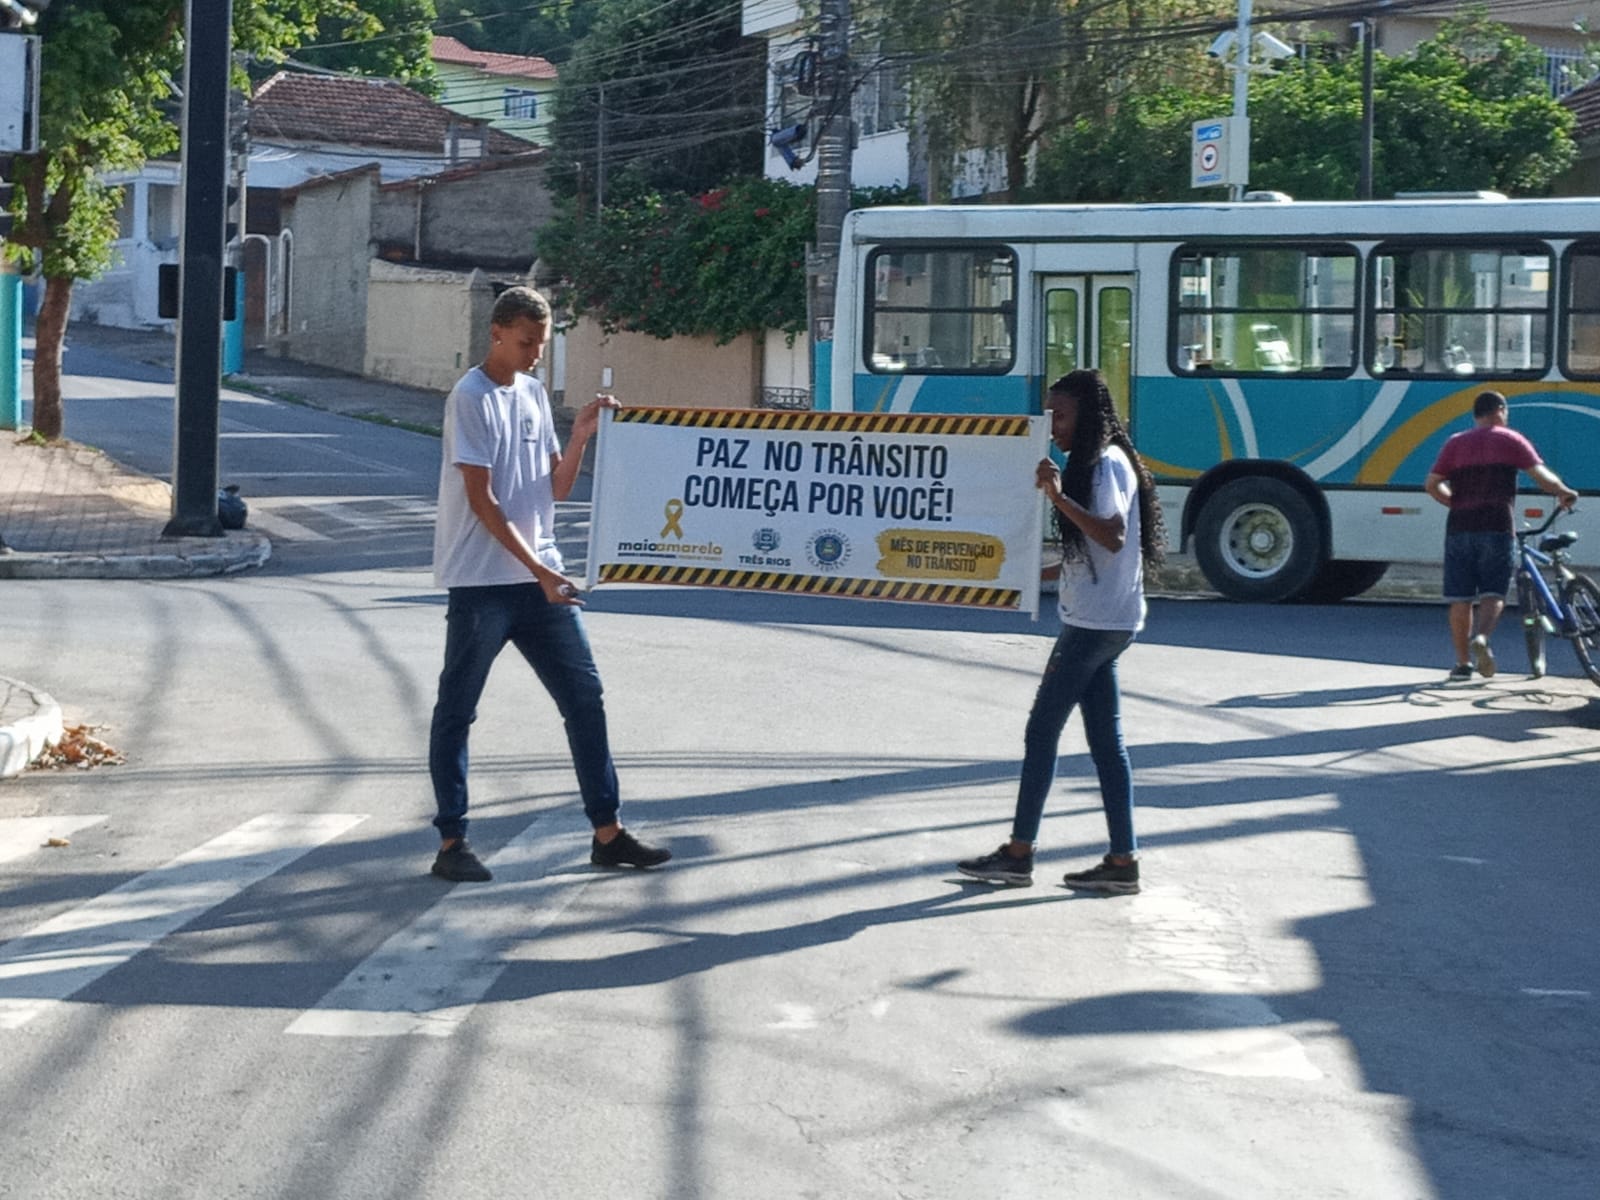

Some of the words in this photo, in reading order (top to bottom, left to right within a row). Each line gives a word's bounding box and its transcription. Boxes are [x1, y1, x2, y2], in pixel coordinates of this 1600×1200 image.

[697, 437, 750, 469] PAZ
[764, 440, 803, 472] NO
[811, 435, 948, 479] TRÂNSITO
[684, 474, 799, 517] COMEÇA
[808, 482, 864, 517] POR
[873, 481, 954, 522] VOCÊ!
[890, 536, 914, 553] MÊS
[916, 540, 931, 554] DE
[932, 541, 995, 559] PREVENÇÃO
[739, 554, 764, 565] TRÊS
[766, 557, 791, 567] RIOS
[907, 554, 922, 569] NO
